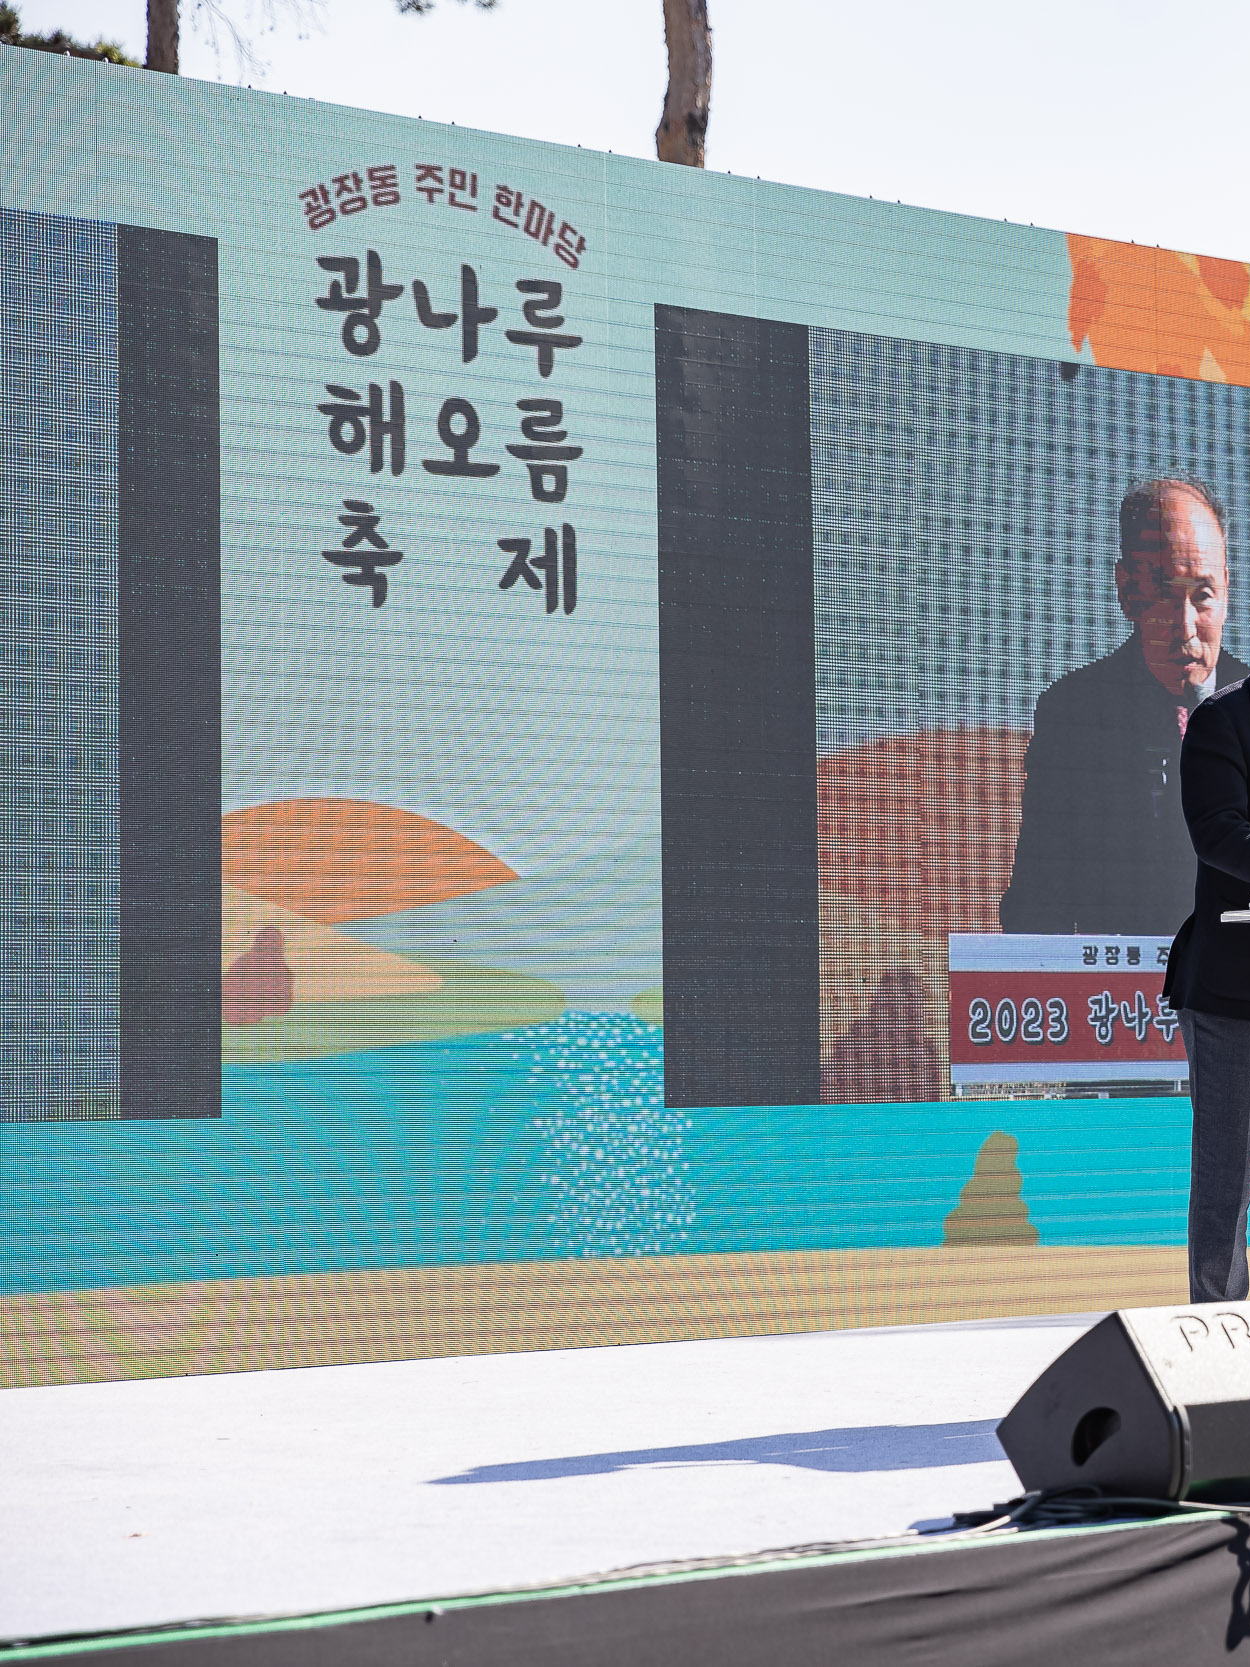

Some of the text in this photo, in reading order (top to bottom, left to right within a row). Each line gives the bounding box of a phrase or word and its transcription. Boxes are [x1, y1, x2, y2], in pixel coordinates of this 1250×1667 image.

[299, 163, 588, 269] 광장동 주민 한마당
[315, 249, 584, 379] 광나루
[316, 379, 584, 502] 해오름
[1082, 945, 1141, 966] 광장동
[968, 989, 1180, 1044] 2023 광나루
